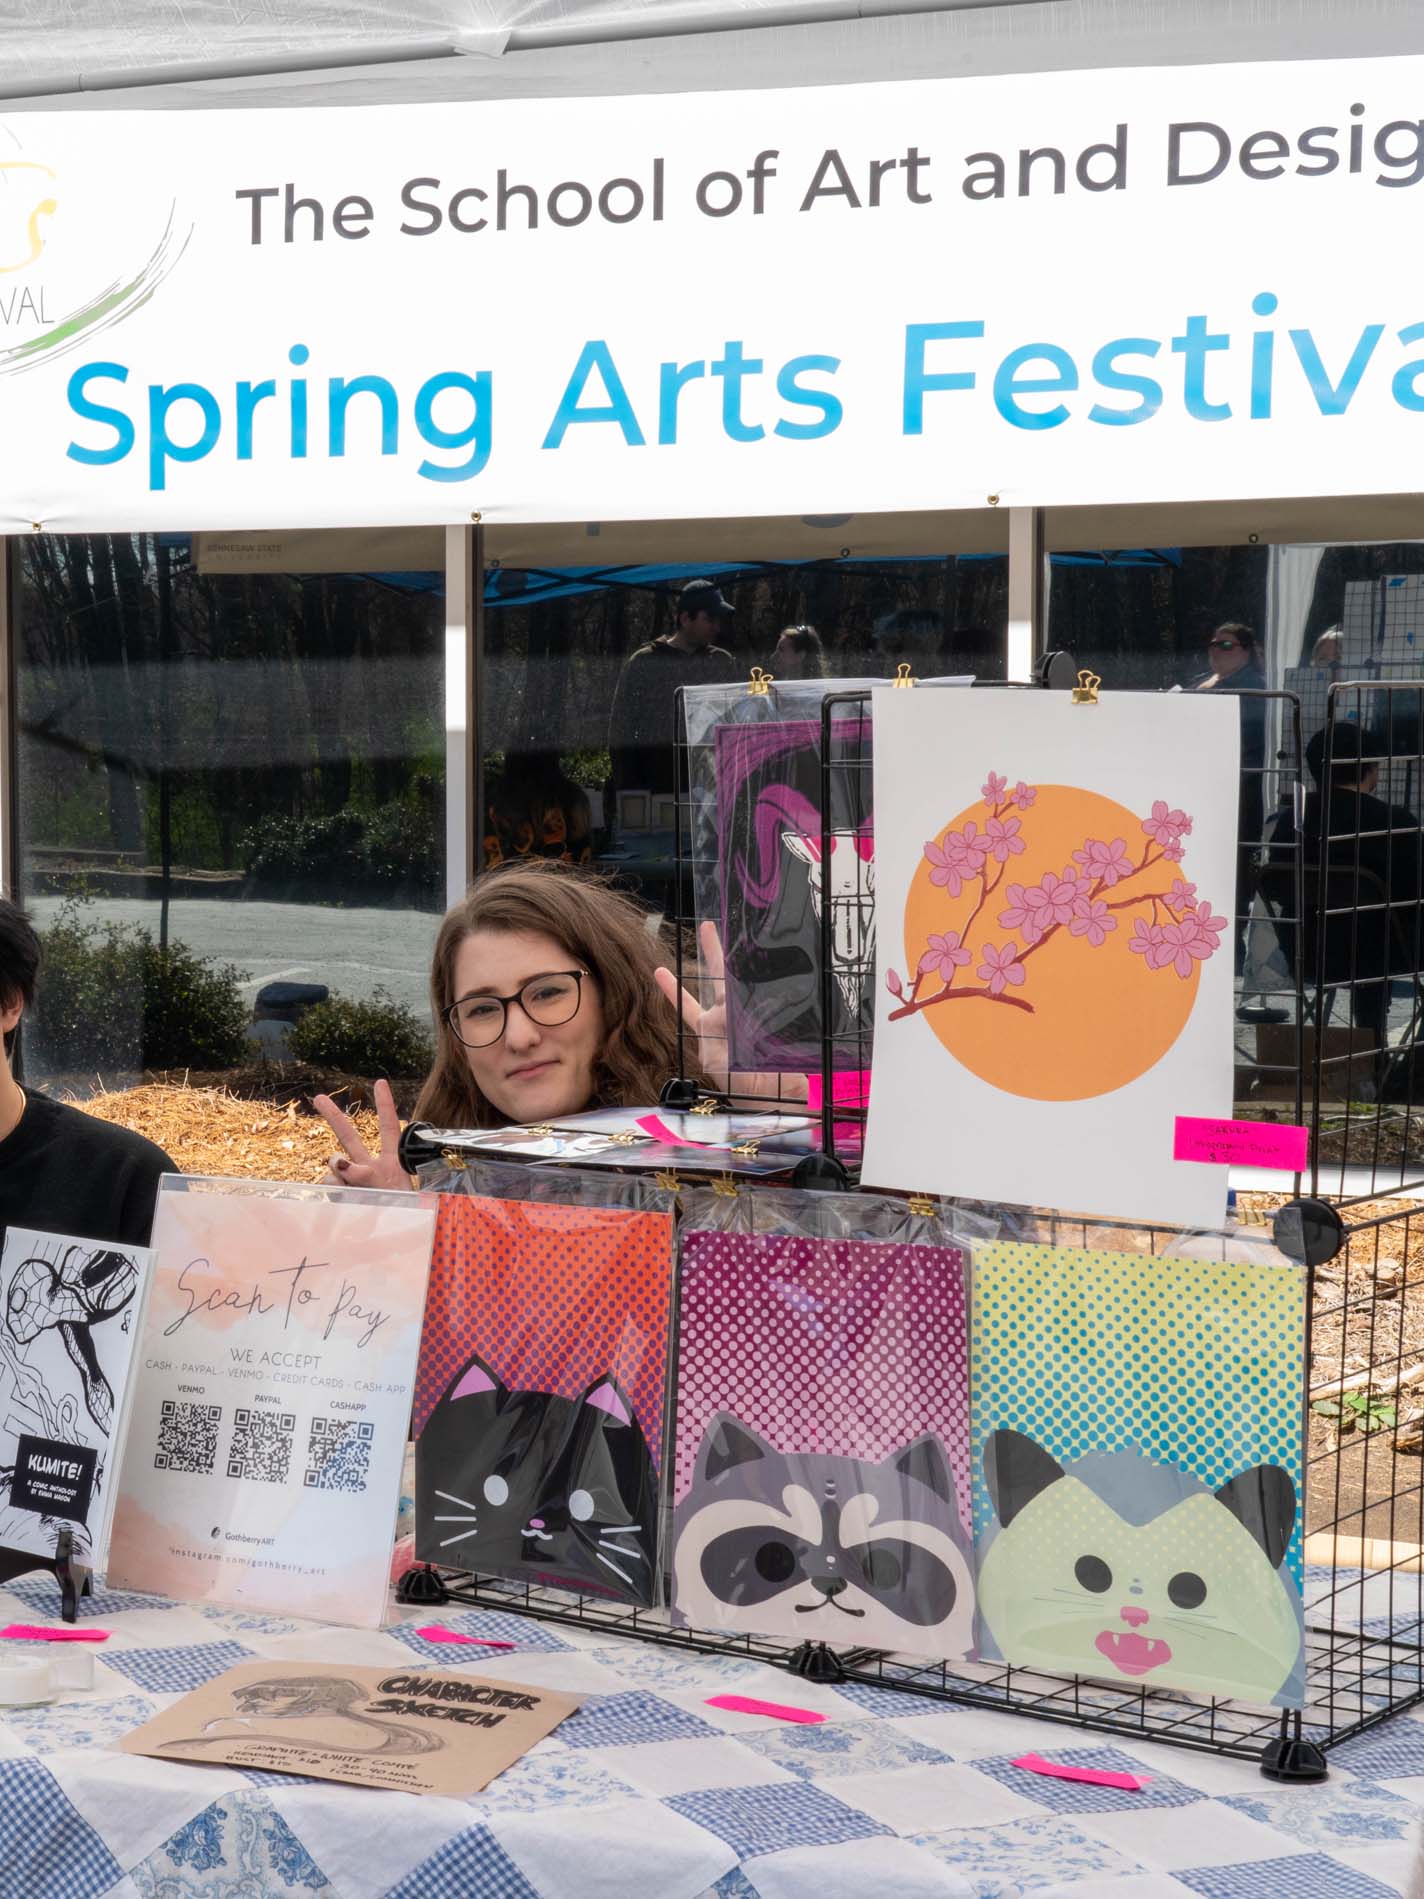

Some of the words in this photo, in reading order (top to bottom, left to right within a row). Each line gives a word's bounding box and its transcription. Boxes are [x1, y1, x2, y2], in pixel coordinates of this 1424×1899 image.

[236, 186, 374, 245] The
[401, 158, 664, 240] School
[696, 150, 777, 218] of
[800, 146, 931, 214] Art
[963, 124, 1128, 202] and
[1166, 102, 1424, 190] Desig
[66, 343, 493, 491] Spring
[541, 339, 844, 450] Arts
[163, 1258, 274, 1337] Scan
[230, 1347, 253, 1363] WE
[260, 1351, 323, 1370] ACCEPT
[145, 1359, 172, 1371] CASH
[181, 1363, 217, 1377] PAYPAL
[227, 1368, 263, 1381] VENMO
[273, 1372, 308, 1387] CREDIT
[310, 1376, 344, 1390] CARDS
[354, 1381, 382, 1393] CASH
[387, 1384, 407, 1394] APP
[177, 1384, 206, 1394] VENMO
[254, 1394, 282, 1406] PAYPAL
[330, 1400, 367, 1412] CASHAPP
[28, 1454, 84, 1481] KUMITE!
[33, 1481, 49, 1490] COMIC
[50, 1485, 77, 1497] ANTHOLOGY
[38, 1489, 53, 1498] EMMA
[377, 1674, 542, 1711] CHARACTER
[364, 1698, 507, 1728] SKETCH
[320, 1752, 368, 1764] WHITE
